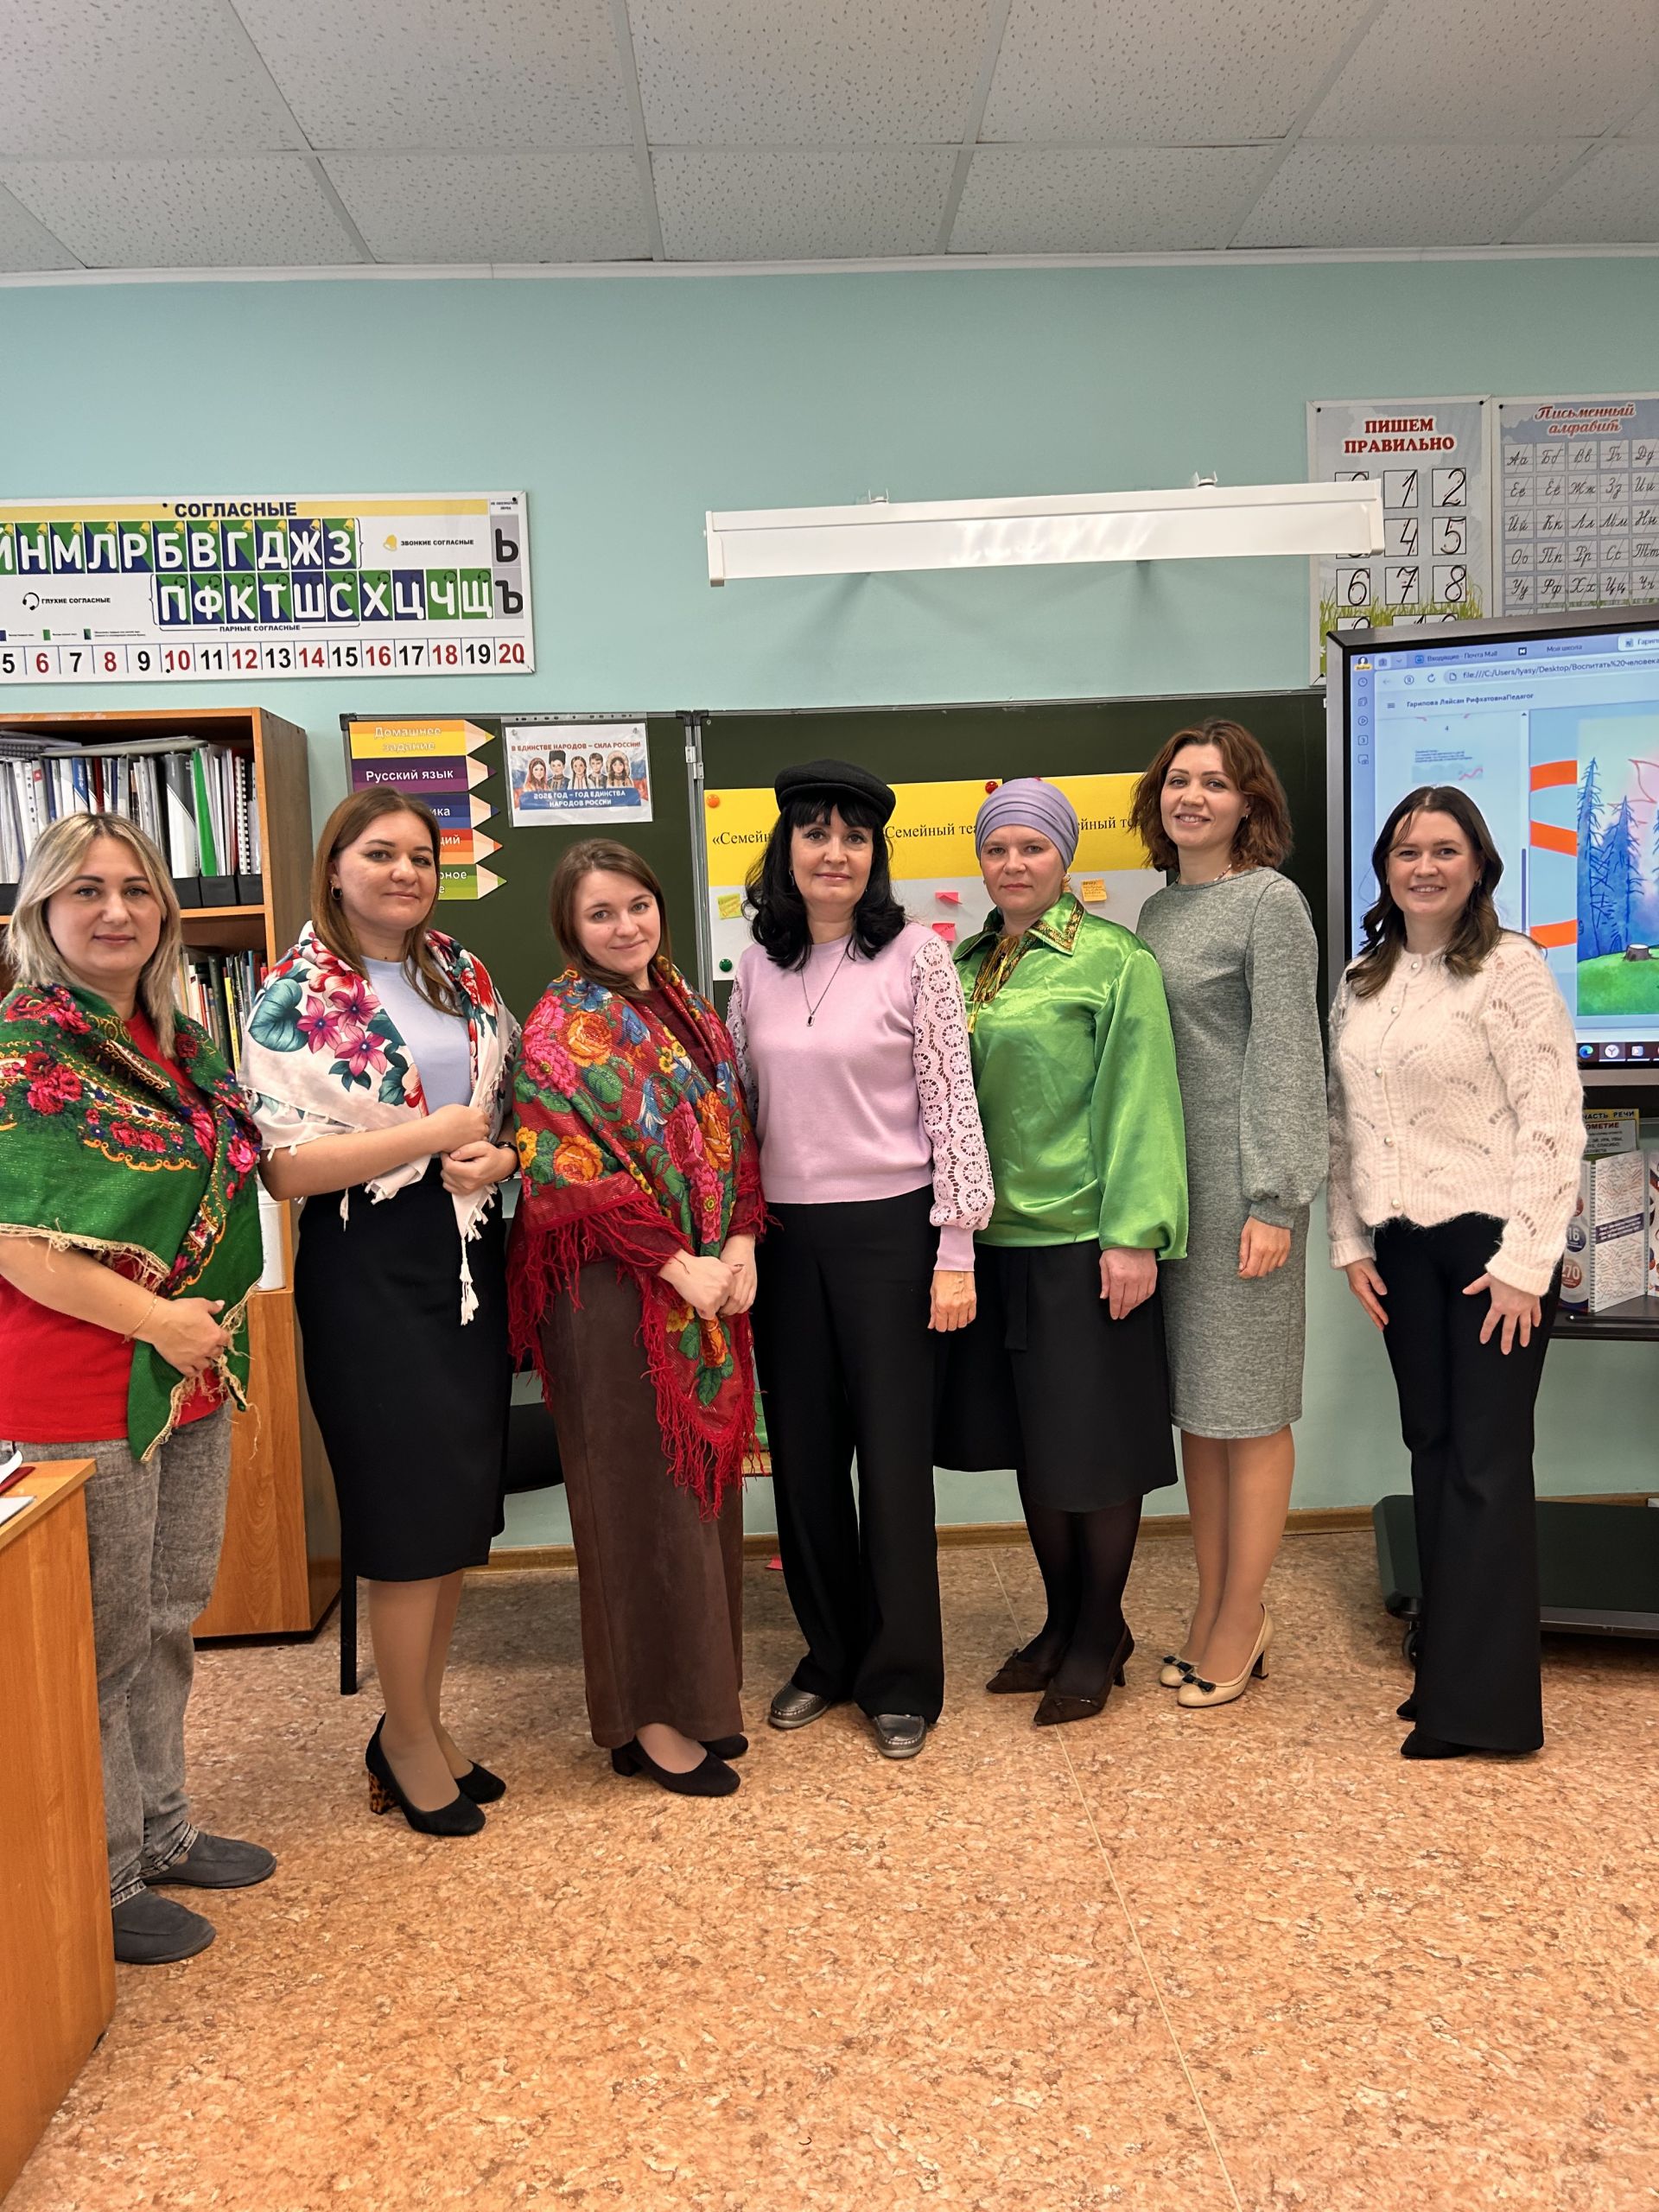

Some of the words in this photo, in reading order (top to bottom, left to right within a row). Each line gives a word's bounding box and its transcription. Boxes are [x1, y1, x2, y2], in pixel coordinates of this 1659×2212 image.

[1535, 404, 1635, 420] Письменный
[1364, 418, 1433, 434] ПИШЕМ
[1548, 419, 1620, 436] алфавит
[1344, 436, 1455, 454] ПРАВИЛЬНО
[1402, 469, 1418, 507] 1
[1442, 468, 1466, 506] 2
[175, 502, 297, 518] СОГЛАСНЫЕ
[1400, 518, 1418, 556] 4
[1440, 517, 1466, 555] 5
[20, 535, 47, 570] Н
[53, 534, 82, 570] М
[88, 534, 117, 569] Л
[123, 533, 148, 569] Р
[157, 532, 183, 569] Б
[191, 532, 217, 568] В
[227, 532, 248, 567] Г
[258, 531, 289, 569] Д
[290, 531, 322, 566] Ж
[328, 531, 352, 565] З
[495, 528, 519, 563] Ь
[1348, 569, 1370, 606] 6
[1396, 566, 1419, 604] 7
[1445, 565, 1466, 602] 8
[161, 586, 187, 621] П
[194, 585, 223, 620] Ф
[230, 584, 255, 620] К
[263, 584, 287, 619] Т
[294, 583, 325, 618] Ш
[329, 583, 353, 618] С
[362, 582, 389, 617] Х
[395, 581, 424, 620] Ц
[430, 581, 455, 616] Ч
[462, 581, 493, 619] Щ
[495, 580, 524, 614] Ъ
[3, 653, 16, 674] 5
[35, 652, 49, 673] 6
[70, 652, 82, 672] 7
[104, 652, 117, 672] 8
[137, 651, 150, 671] 9
[165, 650, 191, 671] 10
[200, 649, 223, 670] 11
[232, 648, 258, 670] 12
[265, 647, 291, 669] 13
[299, 647, 325, 668] 14
[332, 646, 359, 668] 15
[365, 645, 391, 666] 16
[398, 645, 424, 665] 17
[432, 645, 458, 664] 18
[466, 644, 491, 664] 19
[499, 643, 524, 664] 20
[1407, 700, 1439, 709] Гарипова
[374, 727, 441, 739] Домашнее
[384, 741, 435, 752] задание
[365, 769, 418, 784] Русский
[422, 770, 454, 779] язык
[429, 808, 450, 817] ика
[885, 823, 955, 839] Семейный
[959, 825, 976, 835] те
[1077, 817, 1116, 831] йный
[712, 830, 771, 845] «Семей
